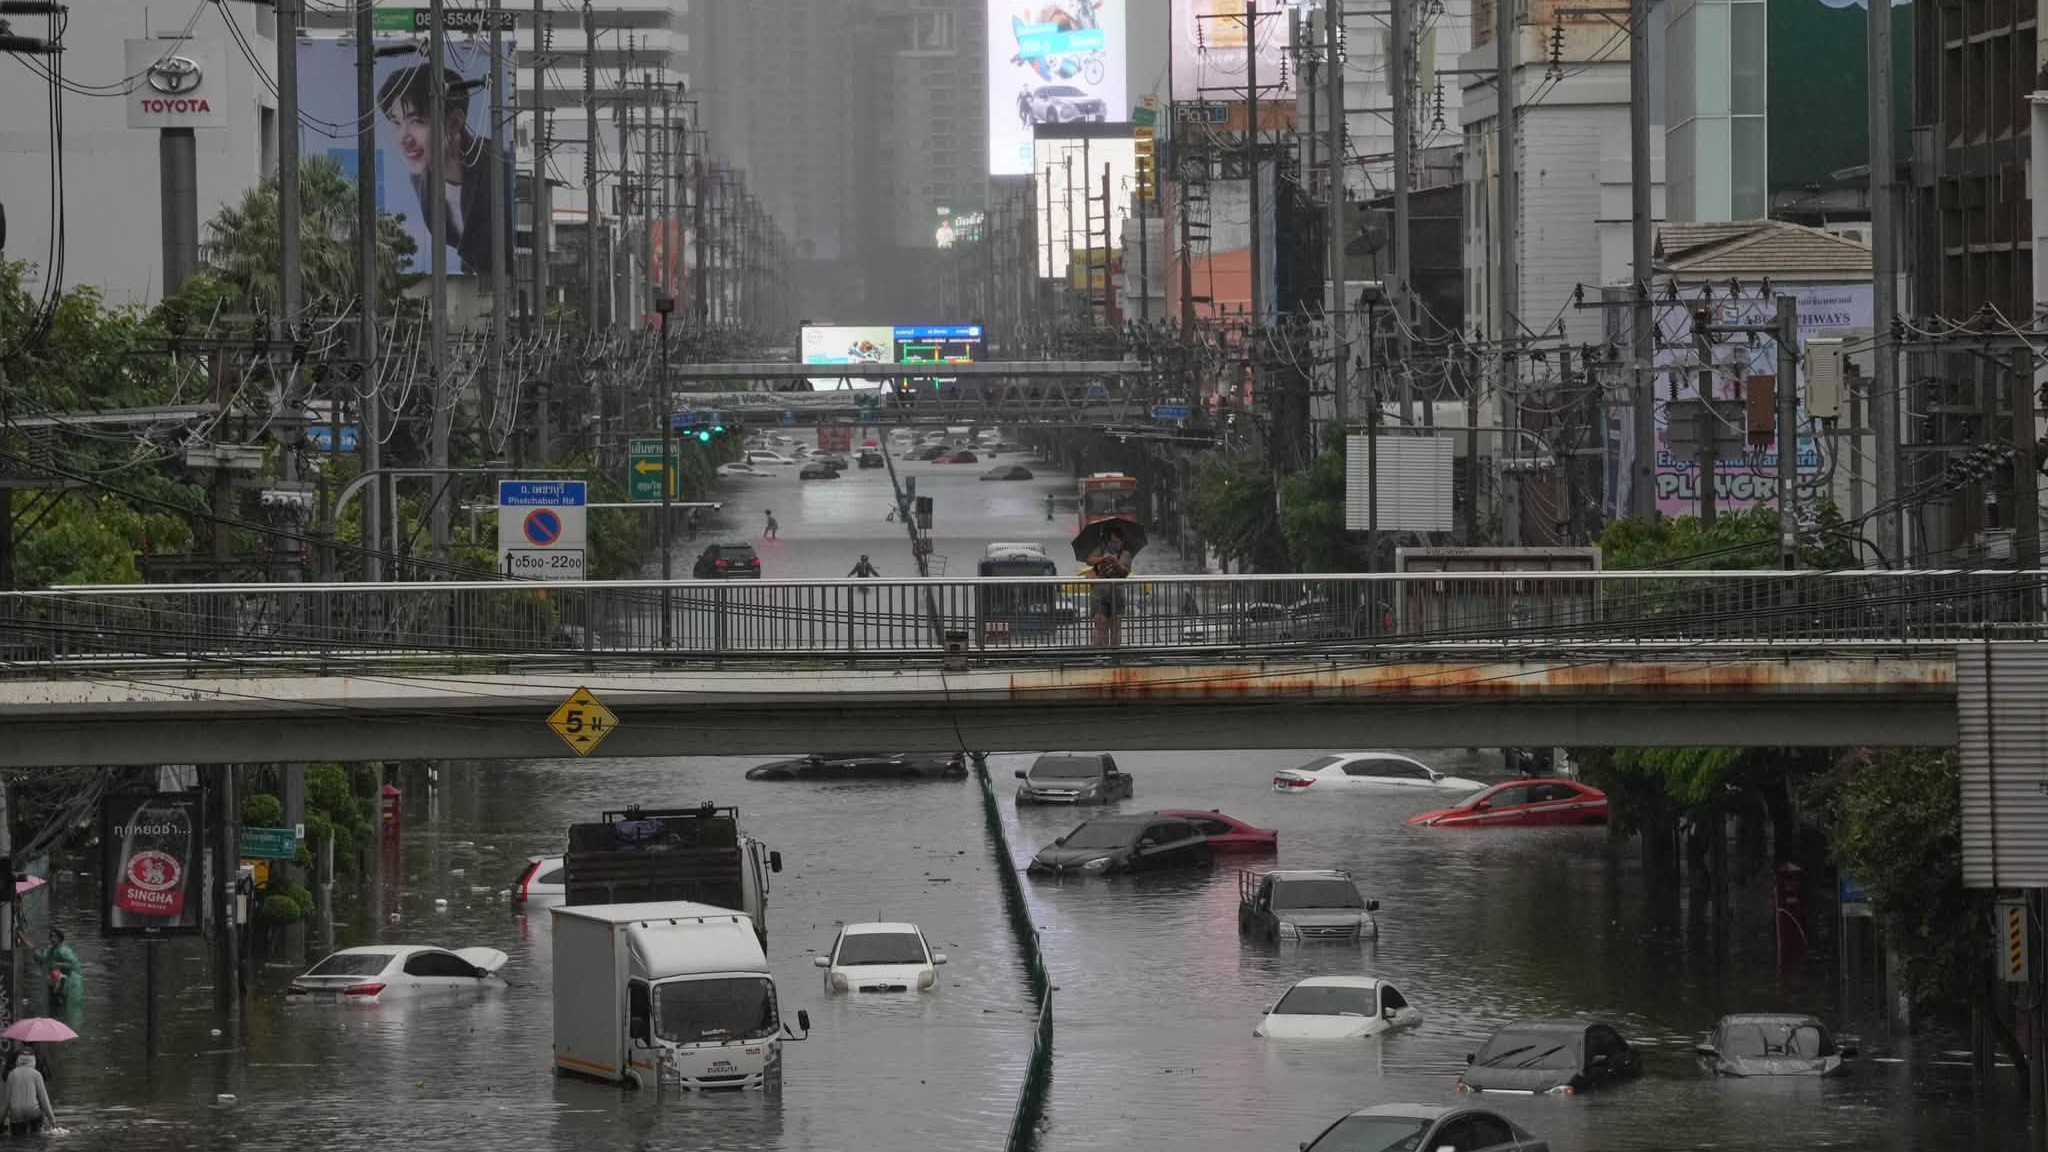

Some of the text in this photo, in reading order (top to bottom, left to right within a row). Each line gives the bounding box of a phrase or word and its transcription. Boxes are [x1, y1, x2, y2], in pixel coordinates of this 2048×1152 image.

[416, 12, 513, 26] 08-5544-2
[141, 99, 210, 113] TOYOTA
[566, 710, 584, 733] 5
[127, 888, 174, 905] SINGHA
